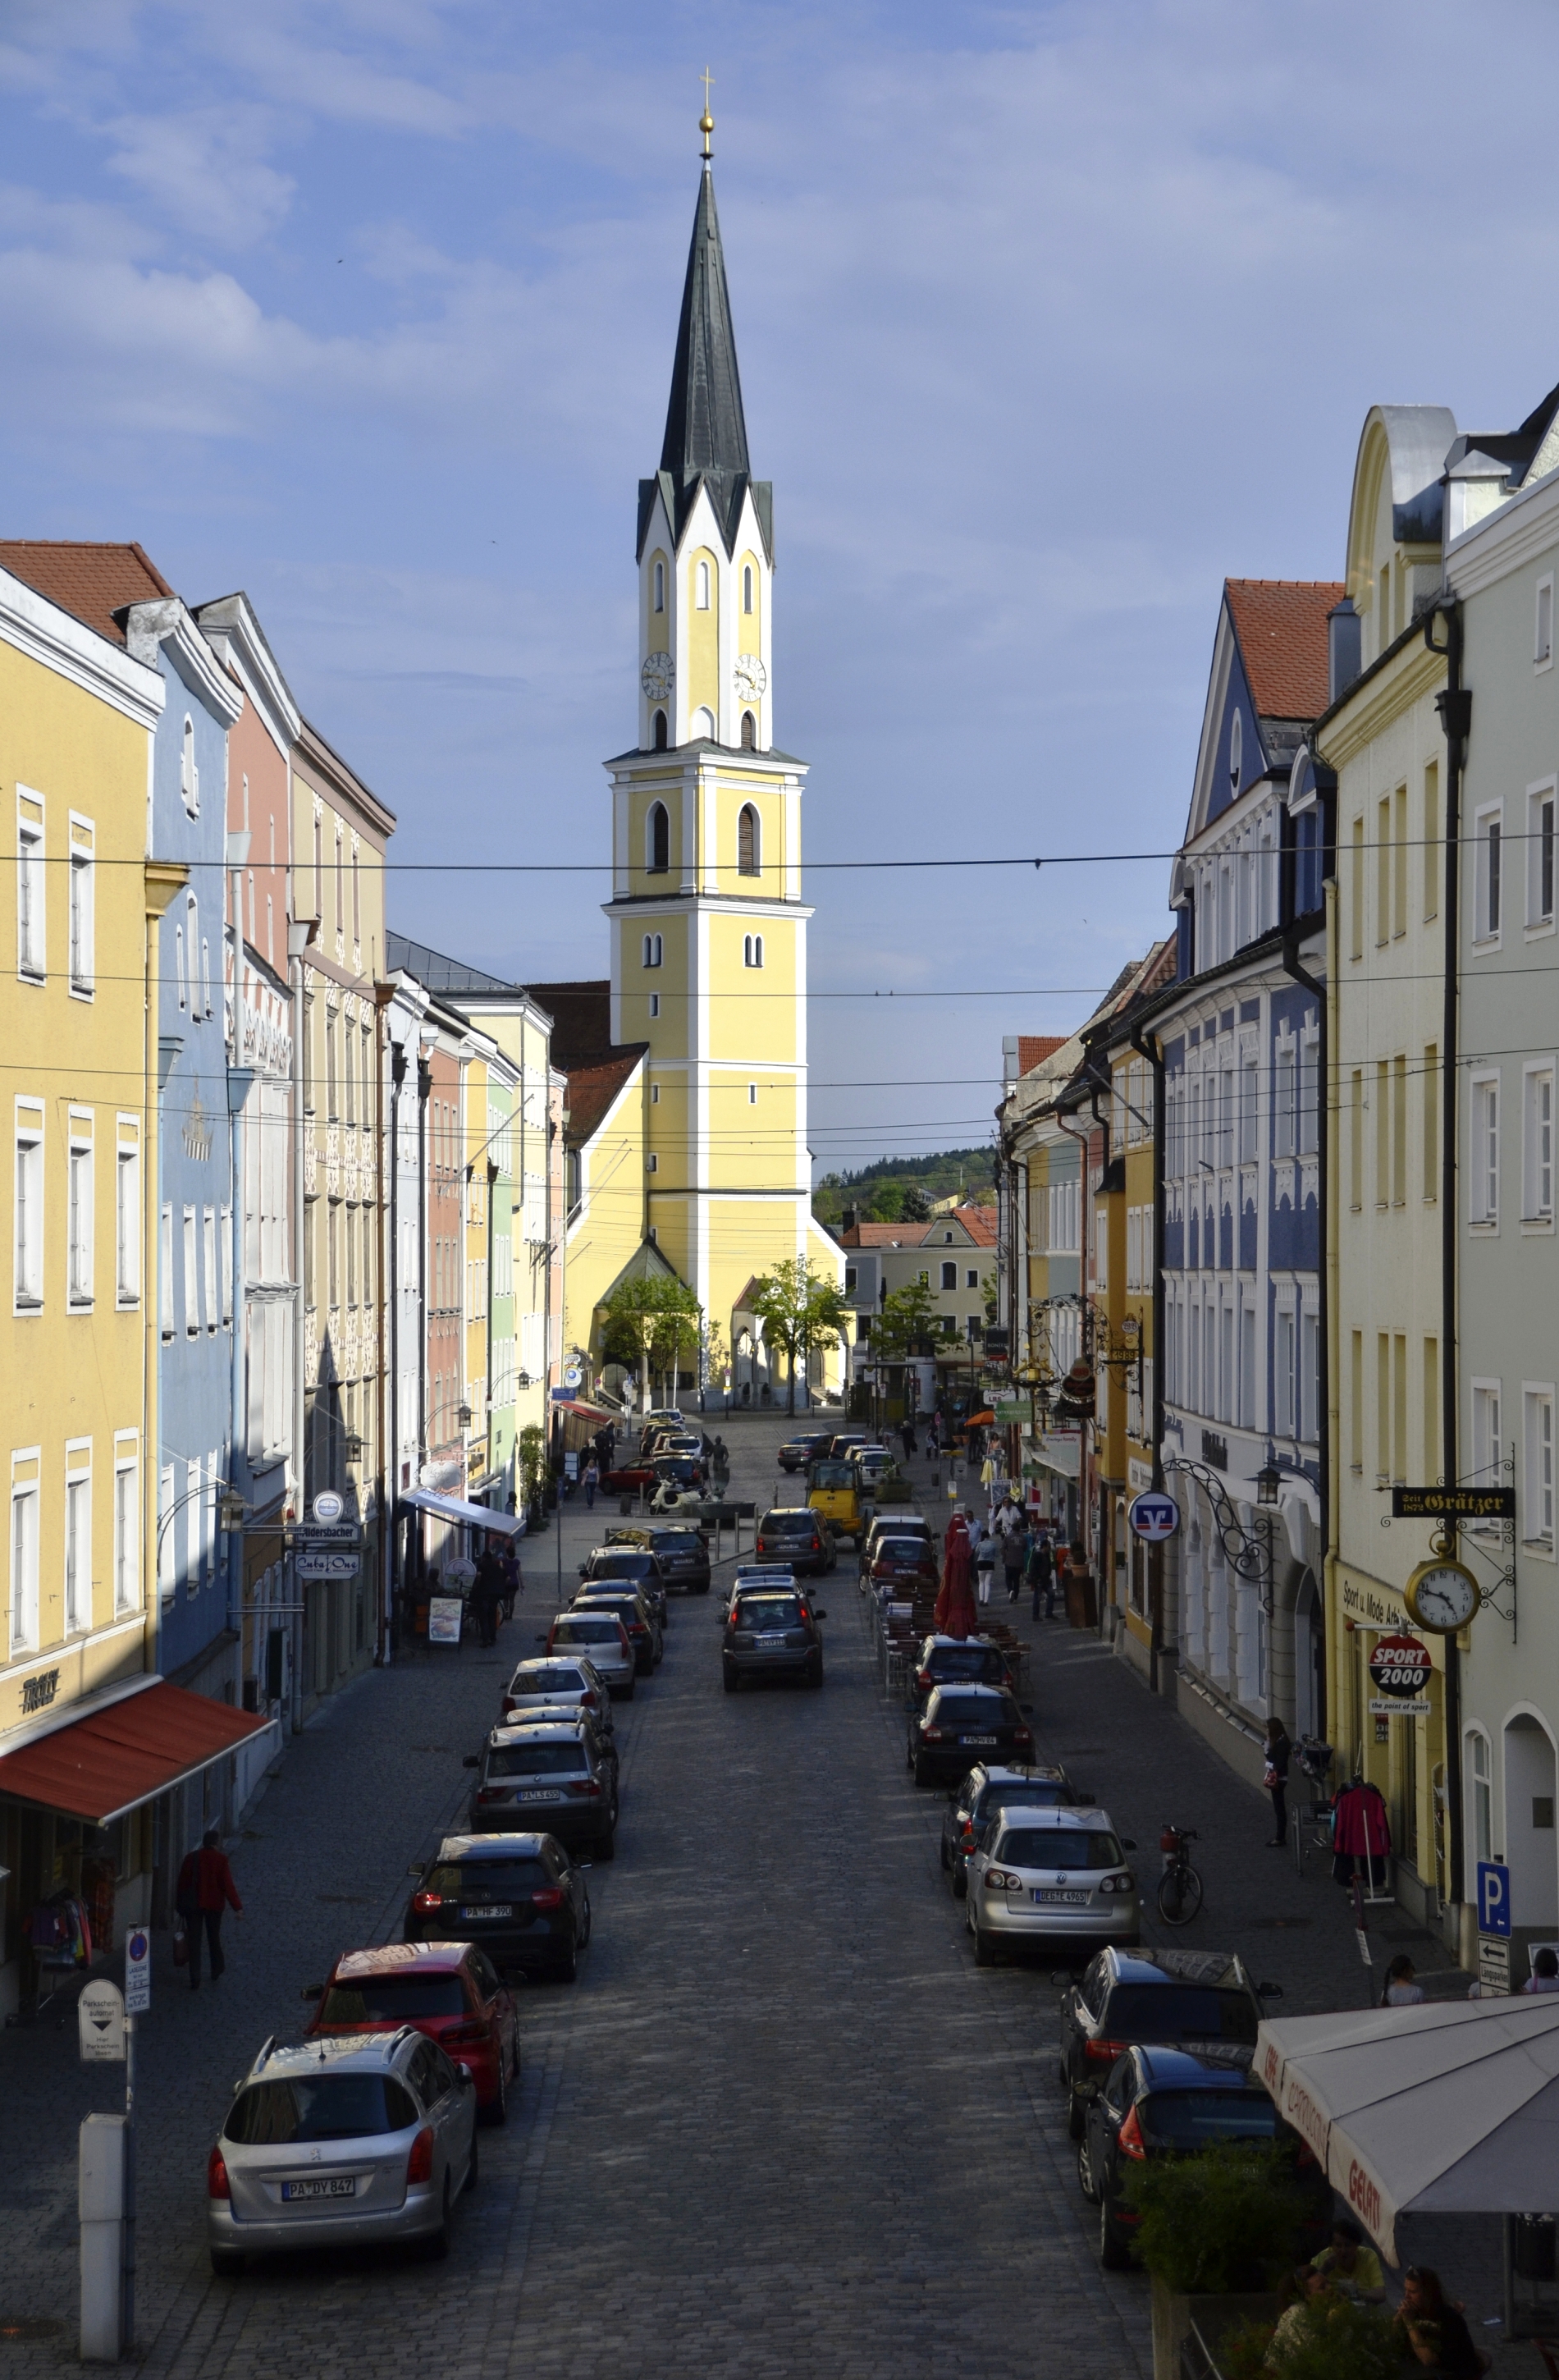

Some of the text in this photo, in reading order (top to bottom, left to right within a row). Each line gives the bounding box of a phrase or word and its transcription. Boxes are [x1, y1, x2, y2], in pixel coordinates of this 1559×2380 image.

[1115, 1351, 1135, 1360] 1989
[1403, 1504, 1424, 1512] 1872
[1424, 1493, 1504, 1516] Grätzer
[302, 1527, 354, 1537] Aldersbacher
[297, 1556, 359, 1568] Cuba One
[1343, 1580, 1359, 1610] Sport
[1366, 1592, 1384, 1623] Mode
[1374, 1648, 1426, 1664] SPORT
[1378, 1668, 1424, 1685] 2000
[1384, 1702, 1401, 1710] point
[1041, 1891, 1085, 1902] DEG E 4965
[1484, 1870, 1502, 1925] P
[467, 1906, 511, 1916] PA HF 390
[290, 2180, 352, 2196] PA DY 847
[1349, 2158, 1380, 2234] GELATI
